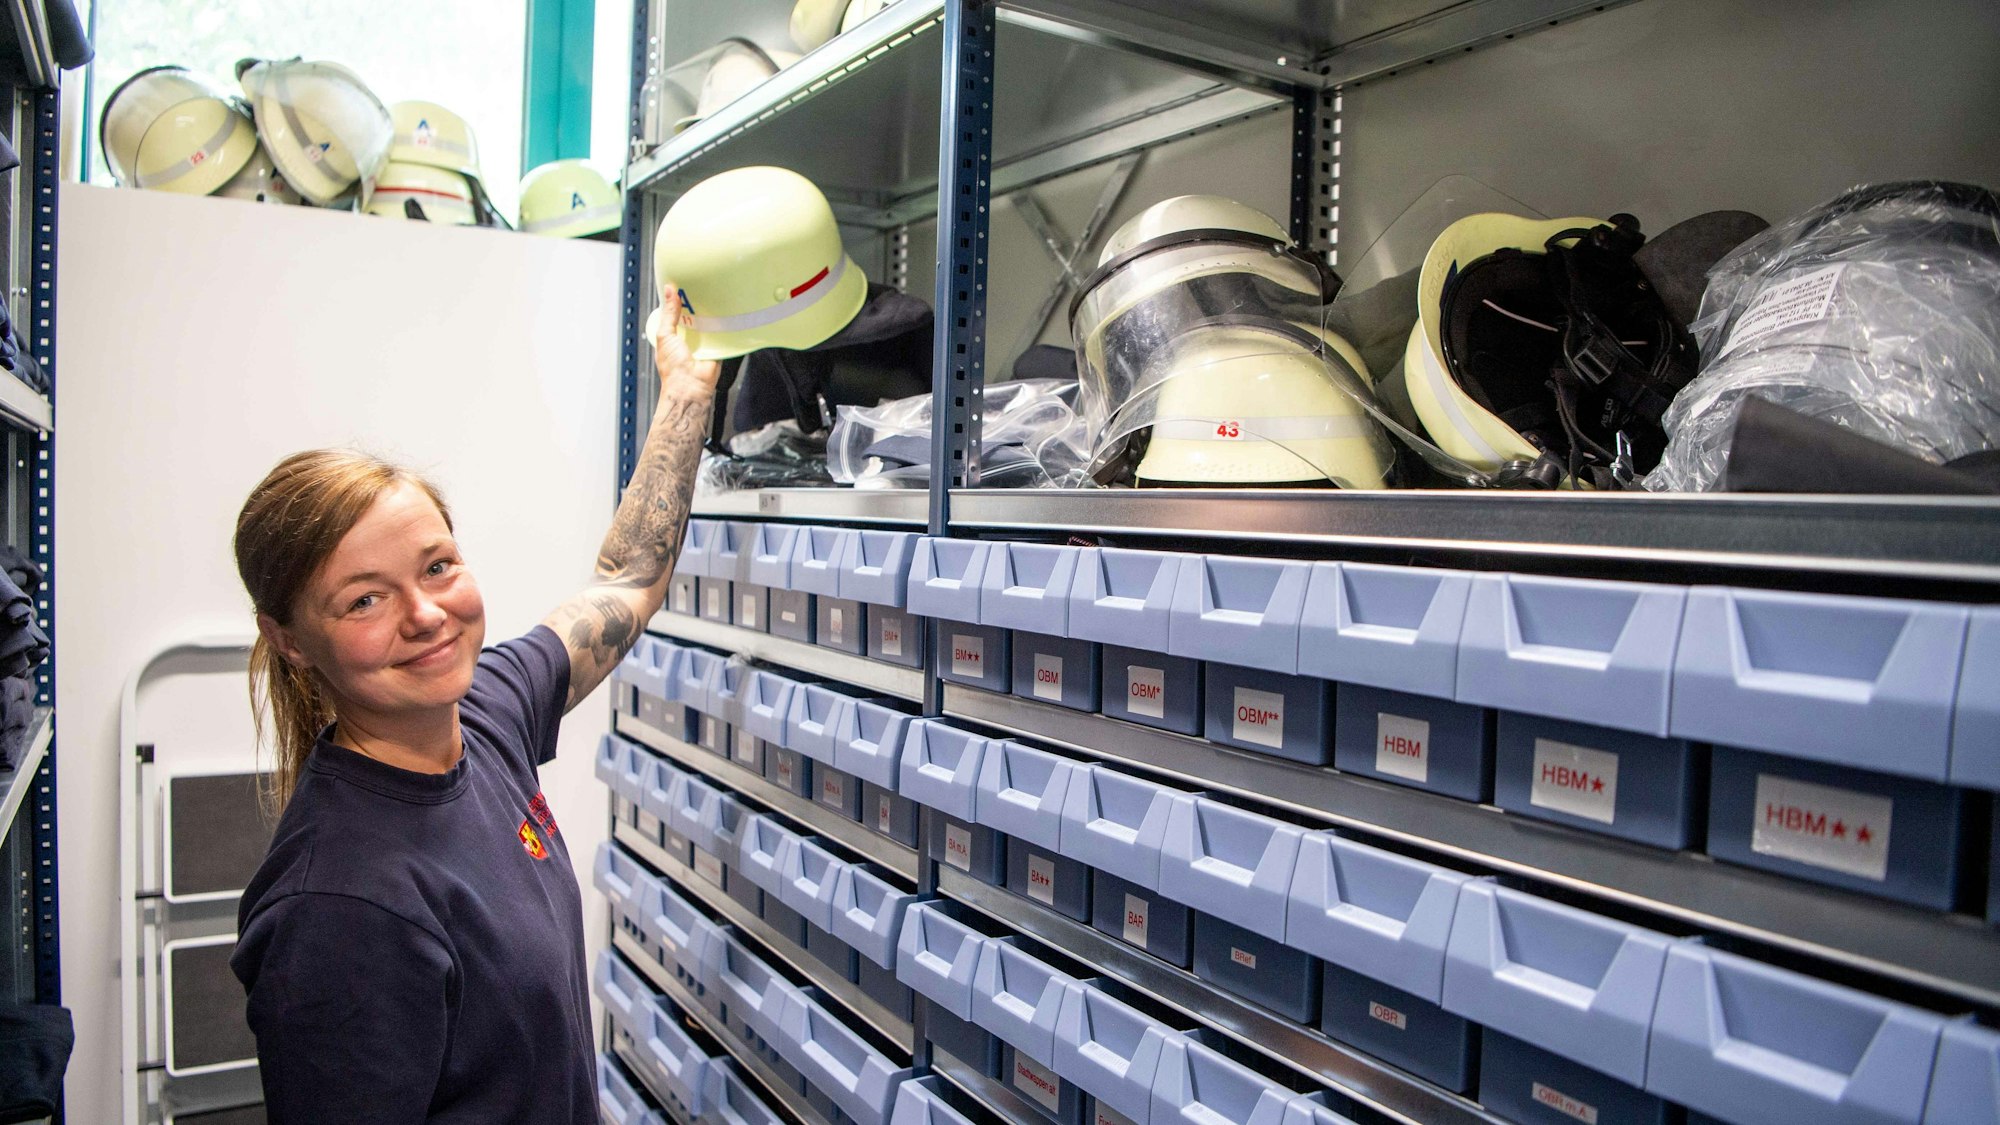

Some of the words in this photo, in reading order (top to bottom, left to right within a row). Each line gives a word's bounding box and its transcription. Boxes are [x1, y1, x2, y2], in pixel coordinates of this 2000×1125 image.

[571, 191, 586, 210] A
[677, 288, 695, 315] A
[1776, 311, 1819, 326] Klappvisier
[1789, 309, 1800, 317] 112
[1216, 421, 1239, 438] 43
[1037, 669, 1059, 685] OBM
[1383, 736, 1422, 758] HBM
[1128, 911, 1144, 928] BAR
[1233, 950, 1253, 965] BRef
[1373, 1005, 1399, 1023] OBR
[1017, 1062, 1049, 1093] Stadtwappen
[1539, 1088, 1564, 1106] OBR
